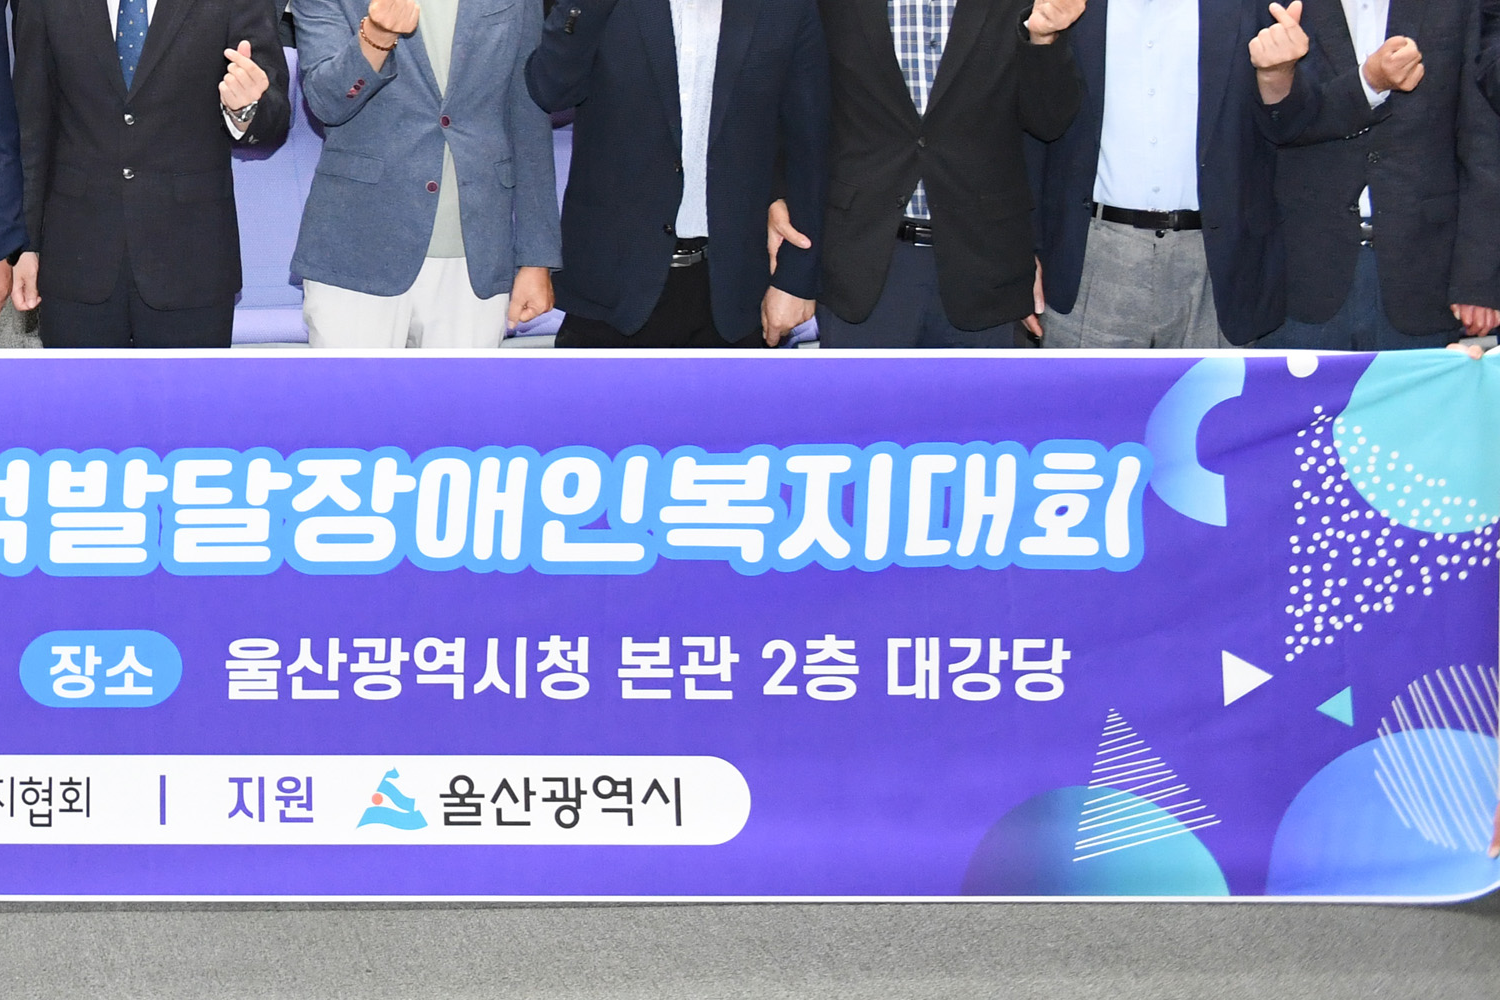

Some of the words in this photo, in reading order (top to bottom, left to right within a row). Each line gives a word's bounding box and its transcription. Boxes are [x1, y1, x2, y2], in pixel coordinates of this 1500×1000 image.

[50, 645, 153, 698] 장소
[225, 635, 590, 700] 울산광역시청
[618, 636, 739, 700] 본관
[762, 634, 859, 701] 2층
[887, 637, 1071, 701] 대강당
[228, 776, 313, 823] 지원
[440, 775, 681, 829] 울산광역시
